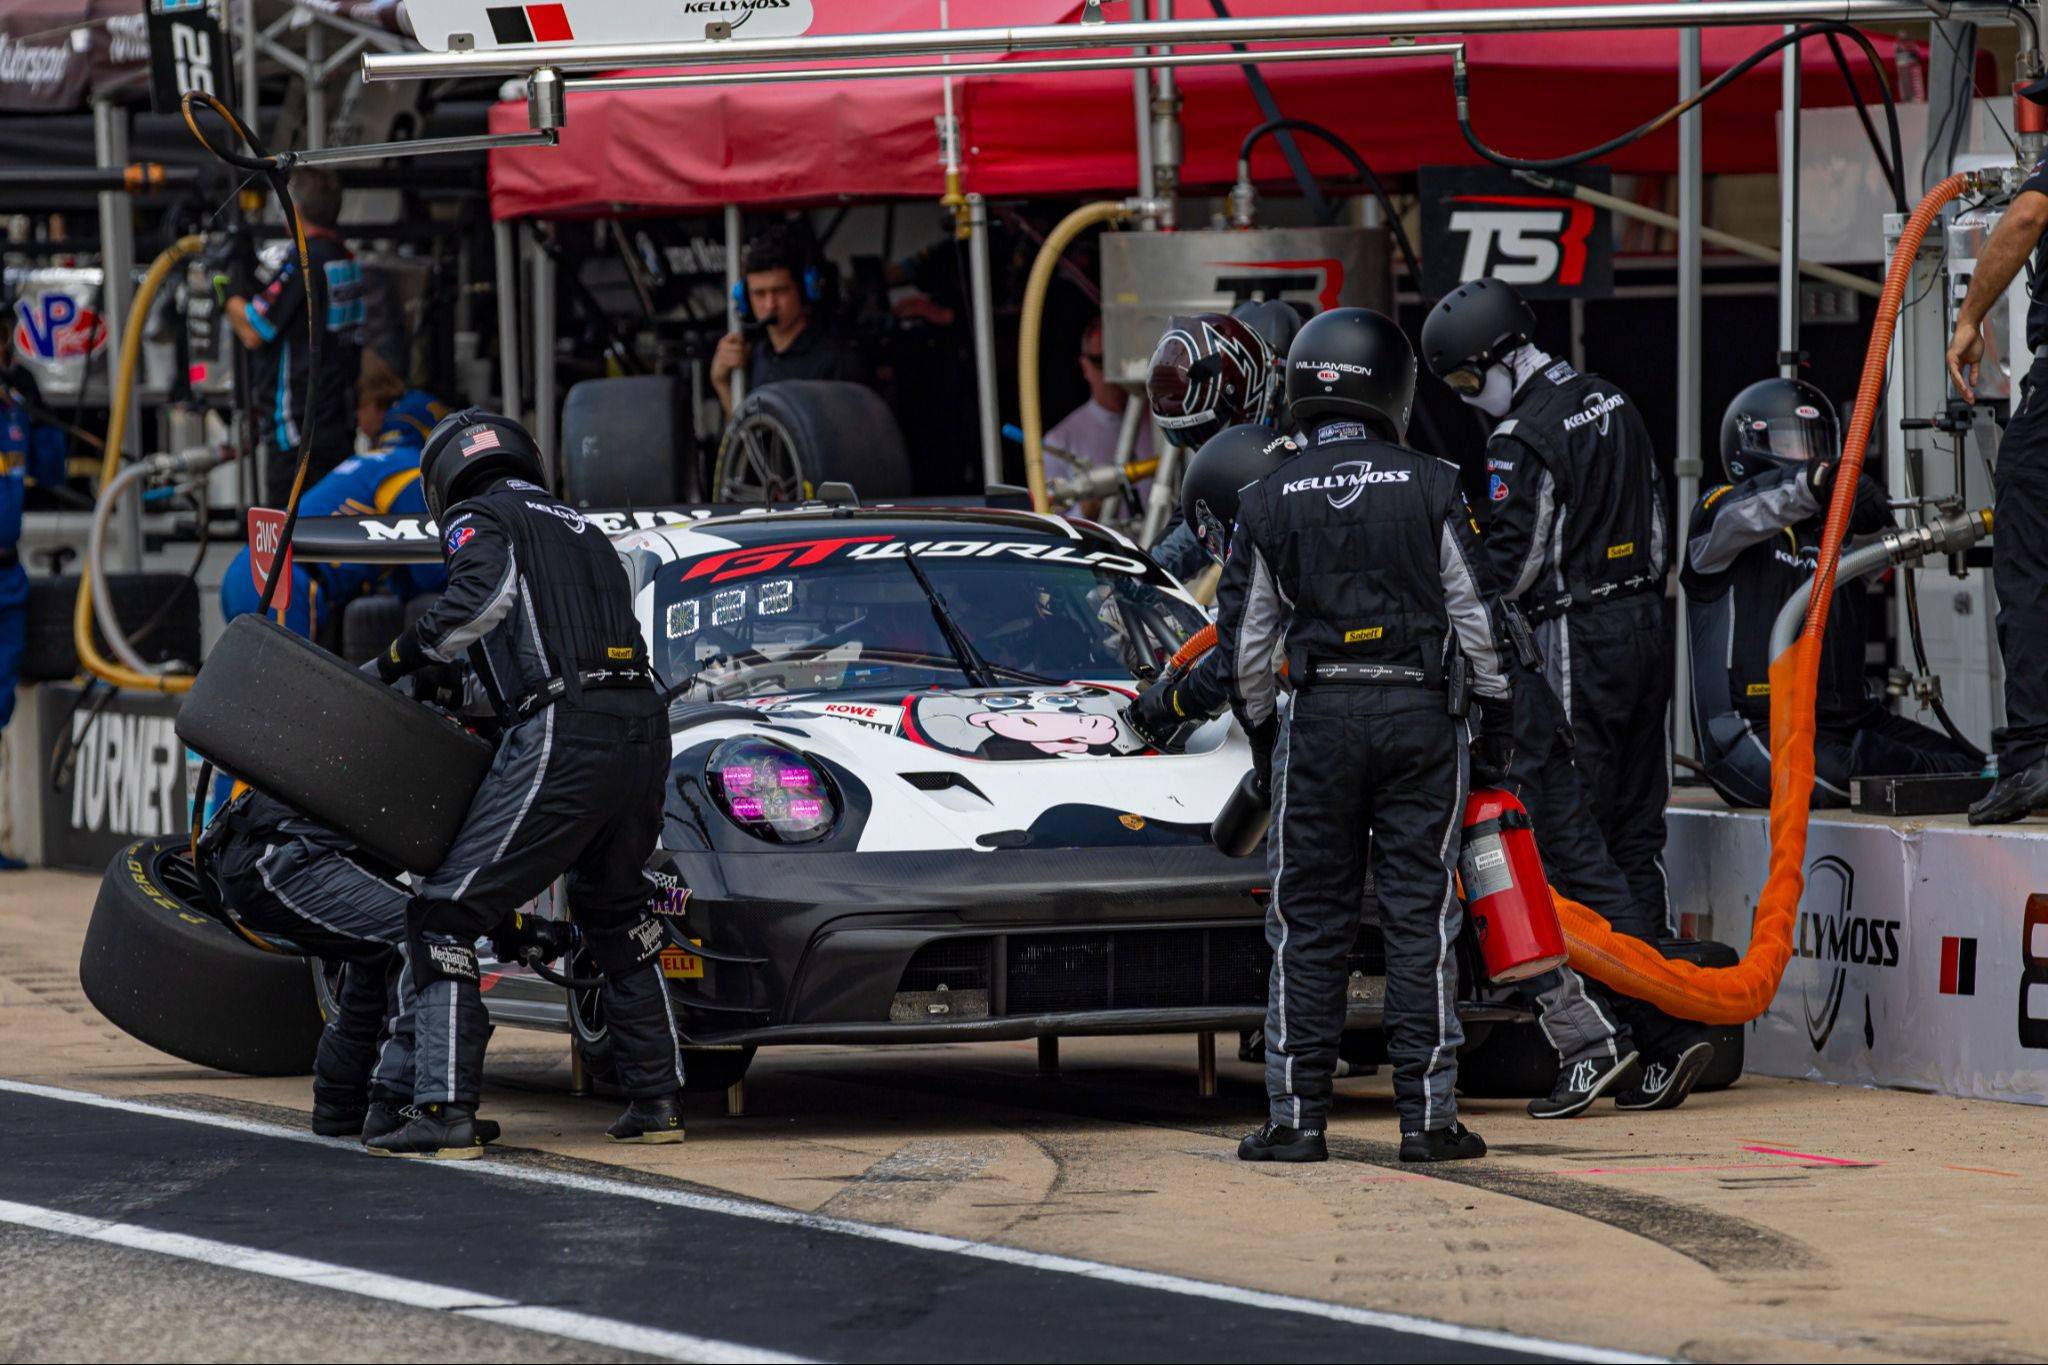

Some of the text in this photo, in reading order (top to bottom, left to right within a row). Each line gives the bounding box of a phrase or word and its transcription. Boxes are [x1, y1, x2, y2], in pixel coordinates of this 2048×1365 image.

[684, 0, 790, 13] KELLYMOSS
[1295, 361, 1372, 376] WILLIAMSON
[1319, 371, 1338, 379] BELL
[1282, 470, 1412, 495] KELLYMOSS
[256, 520, 279, 554] aws
[680, 535, 1147, 583] GT WORLD
[825, 703, 877, 718] ROWE
[71, 709, 179, 837] TURNER
[663, 957, 695, 970] ELLI
